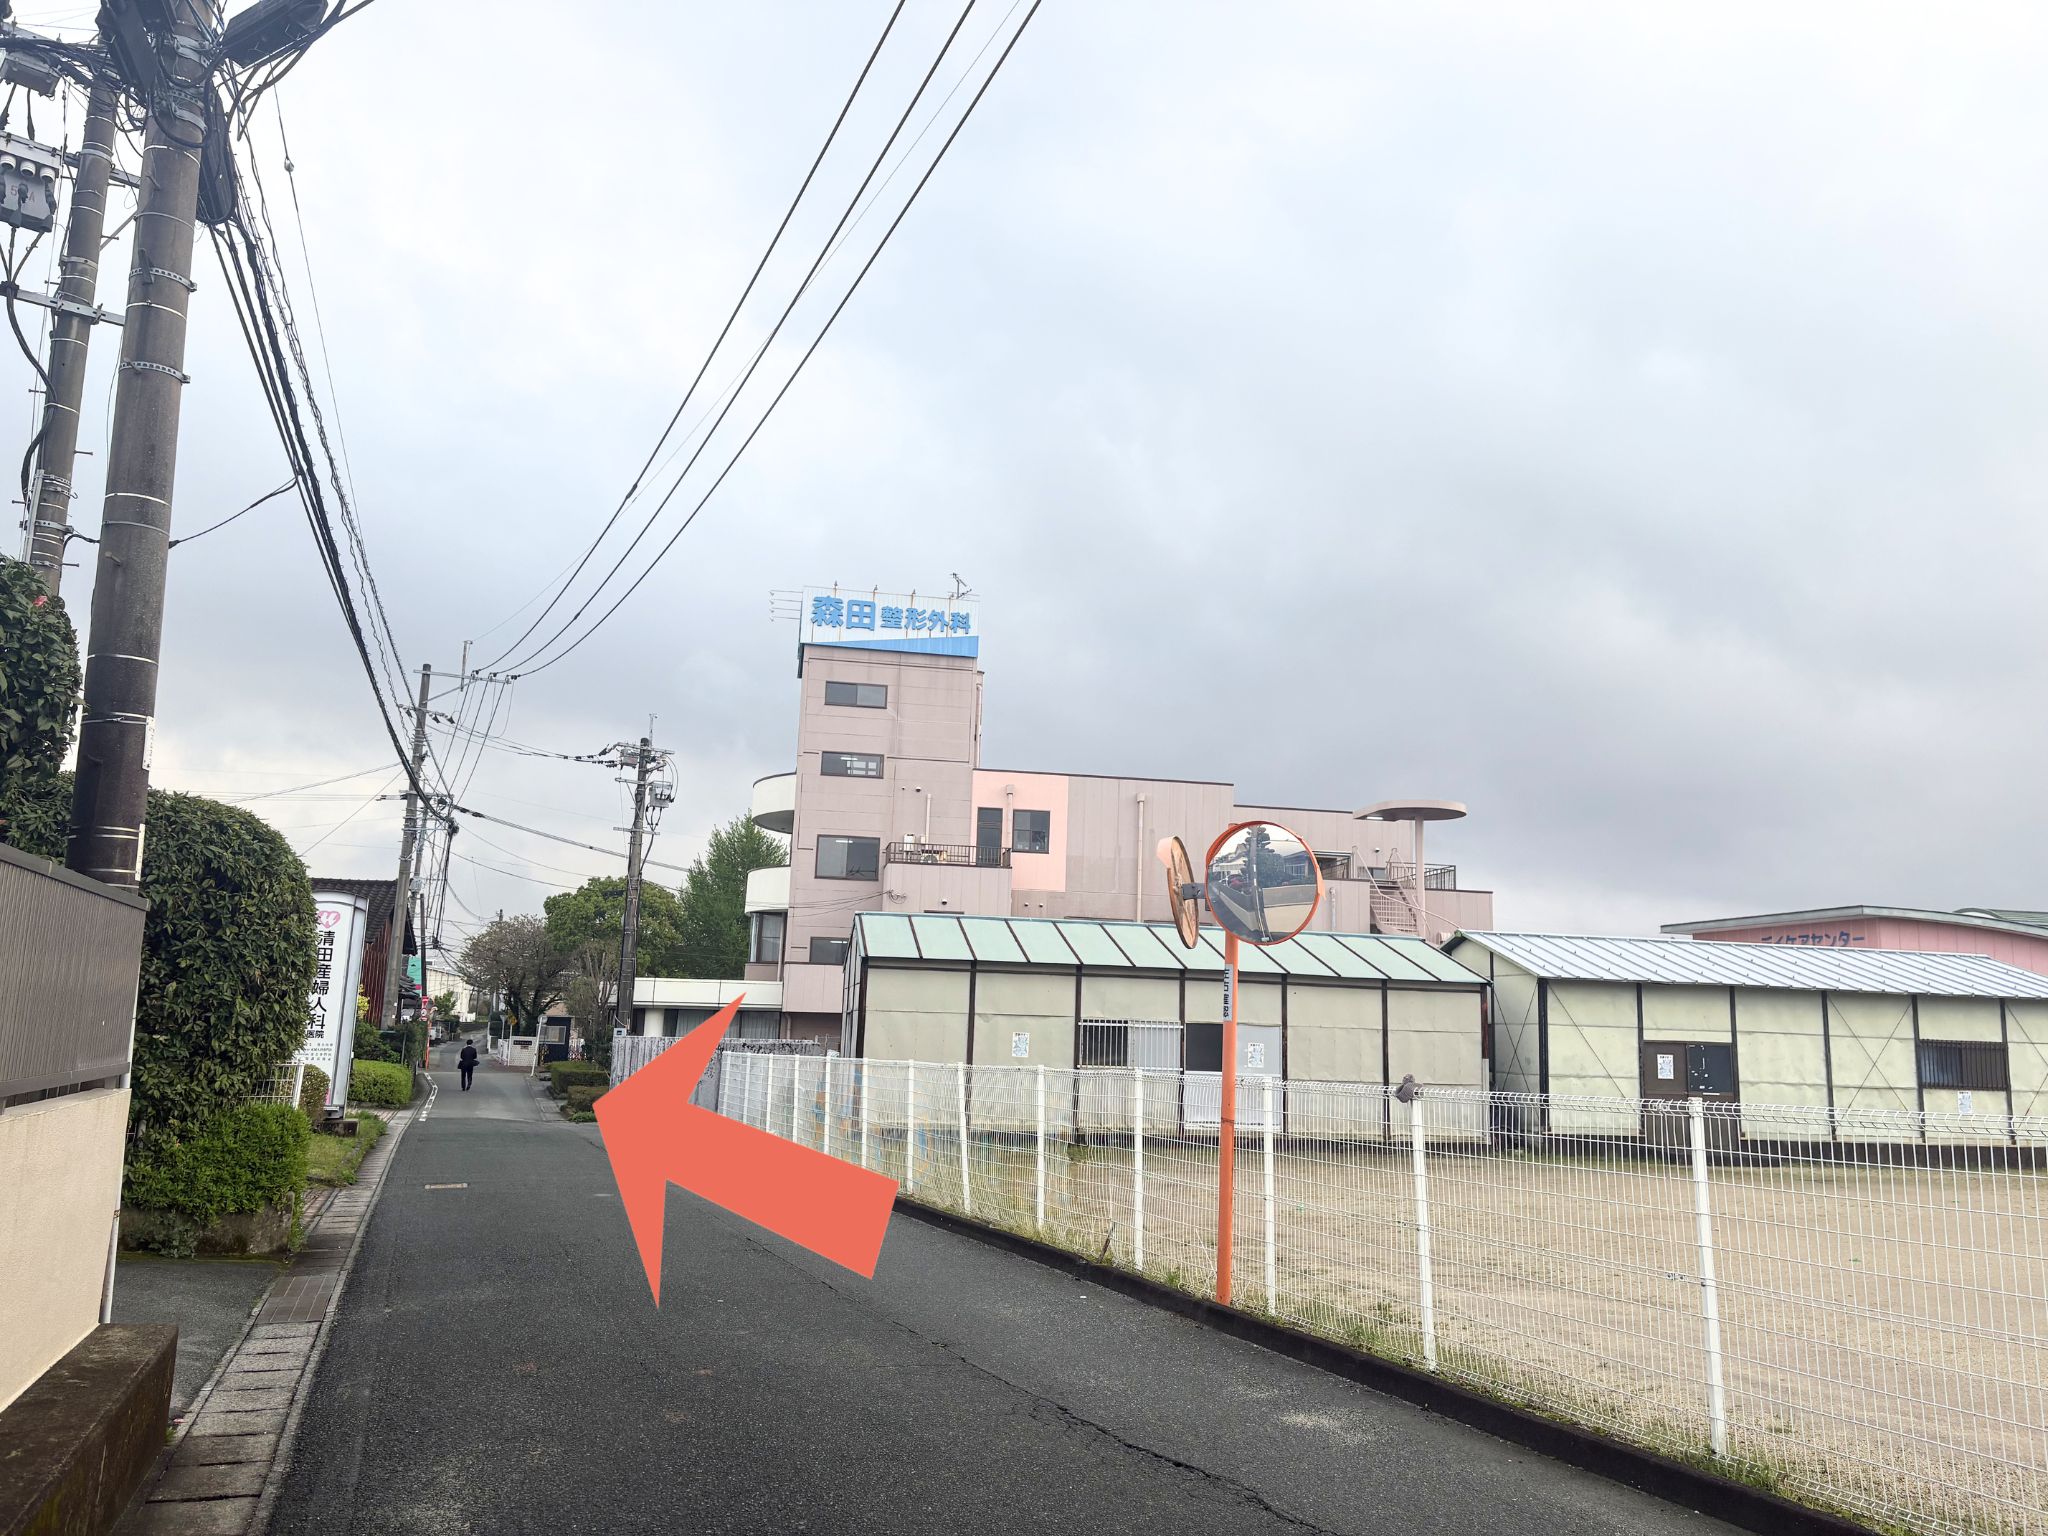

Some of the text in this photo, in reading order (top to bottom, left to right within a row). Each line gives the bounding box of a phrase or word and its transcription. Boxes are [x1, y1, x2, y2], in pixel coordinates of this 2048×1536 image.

[811, 595, 972, 635] 森田整形外科
[307, 930, 336, 1030] 清田産婦人科
